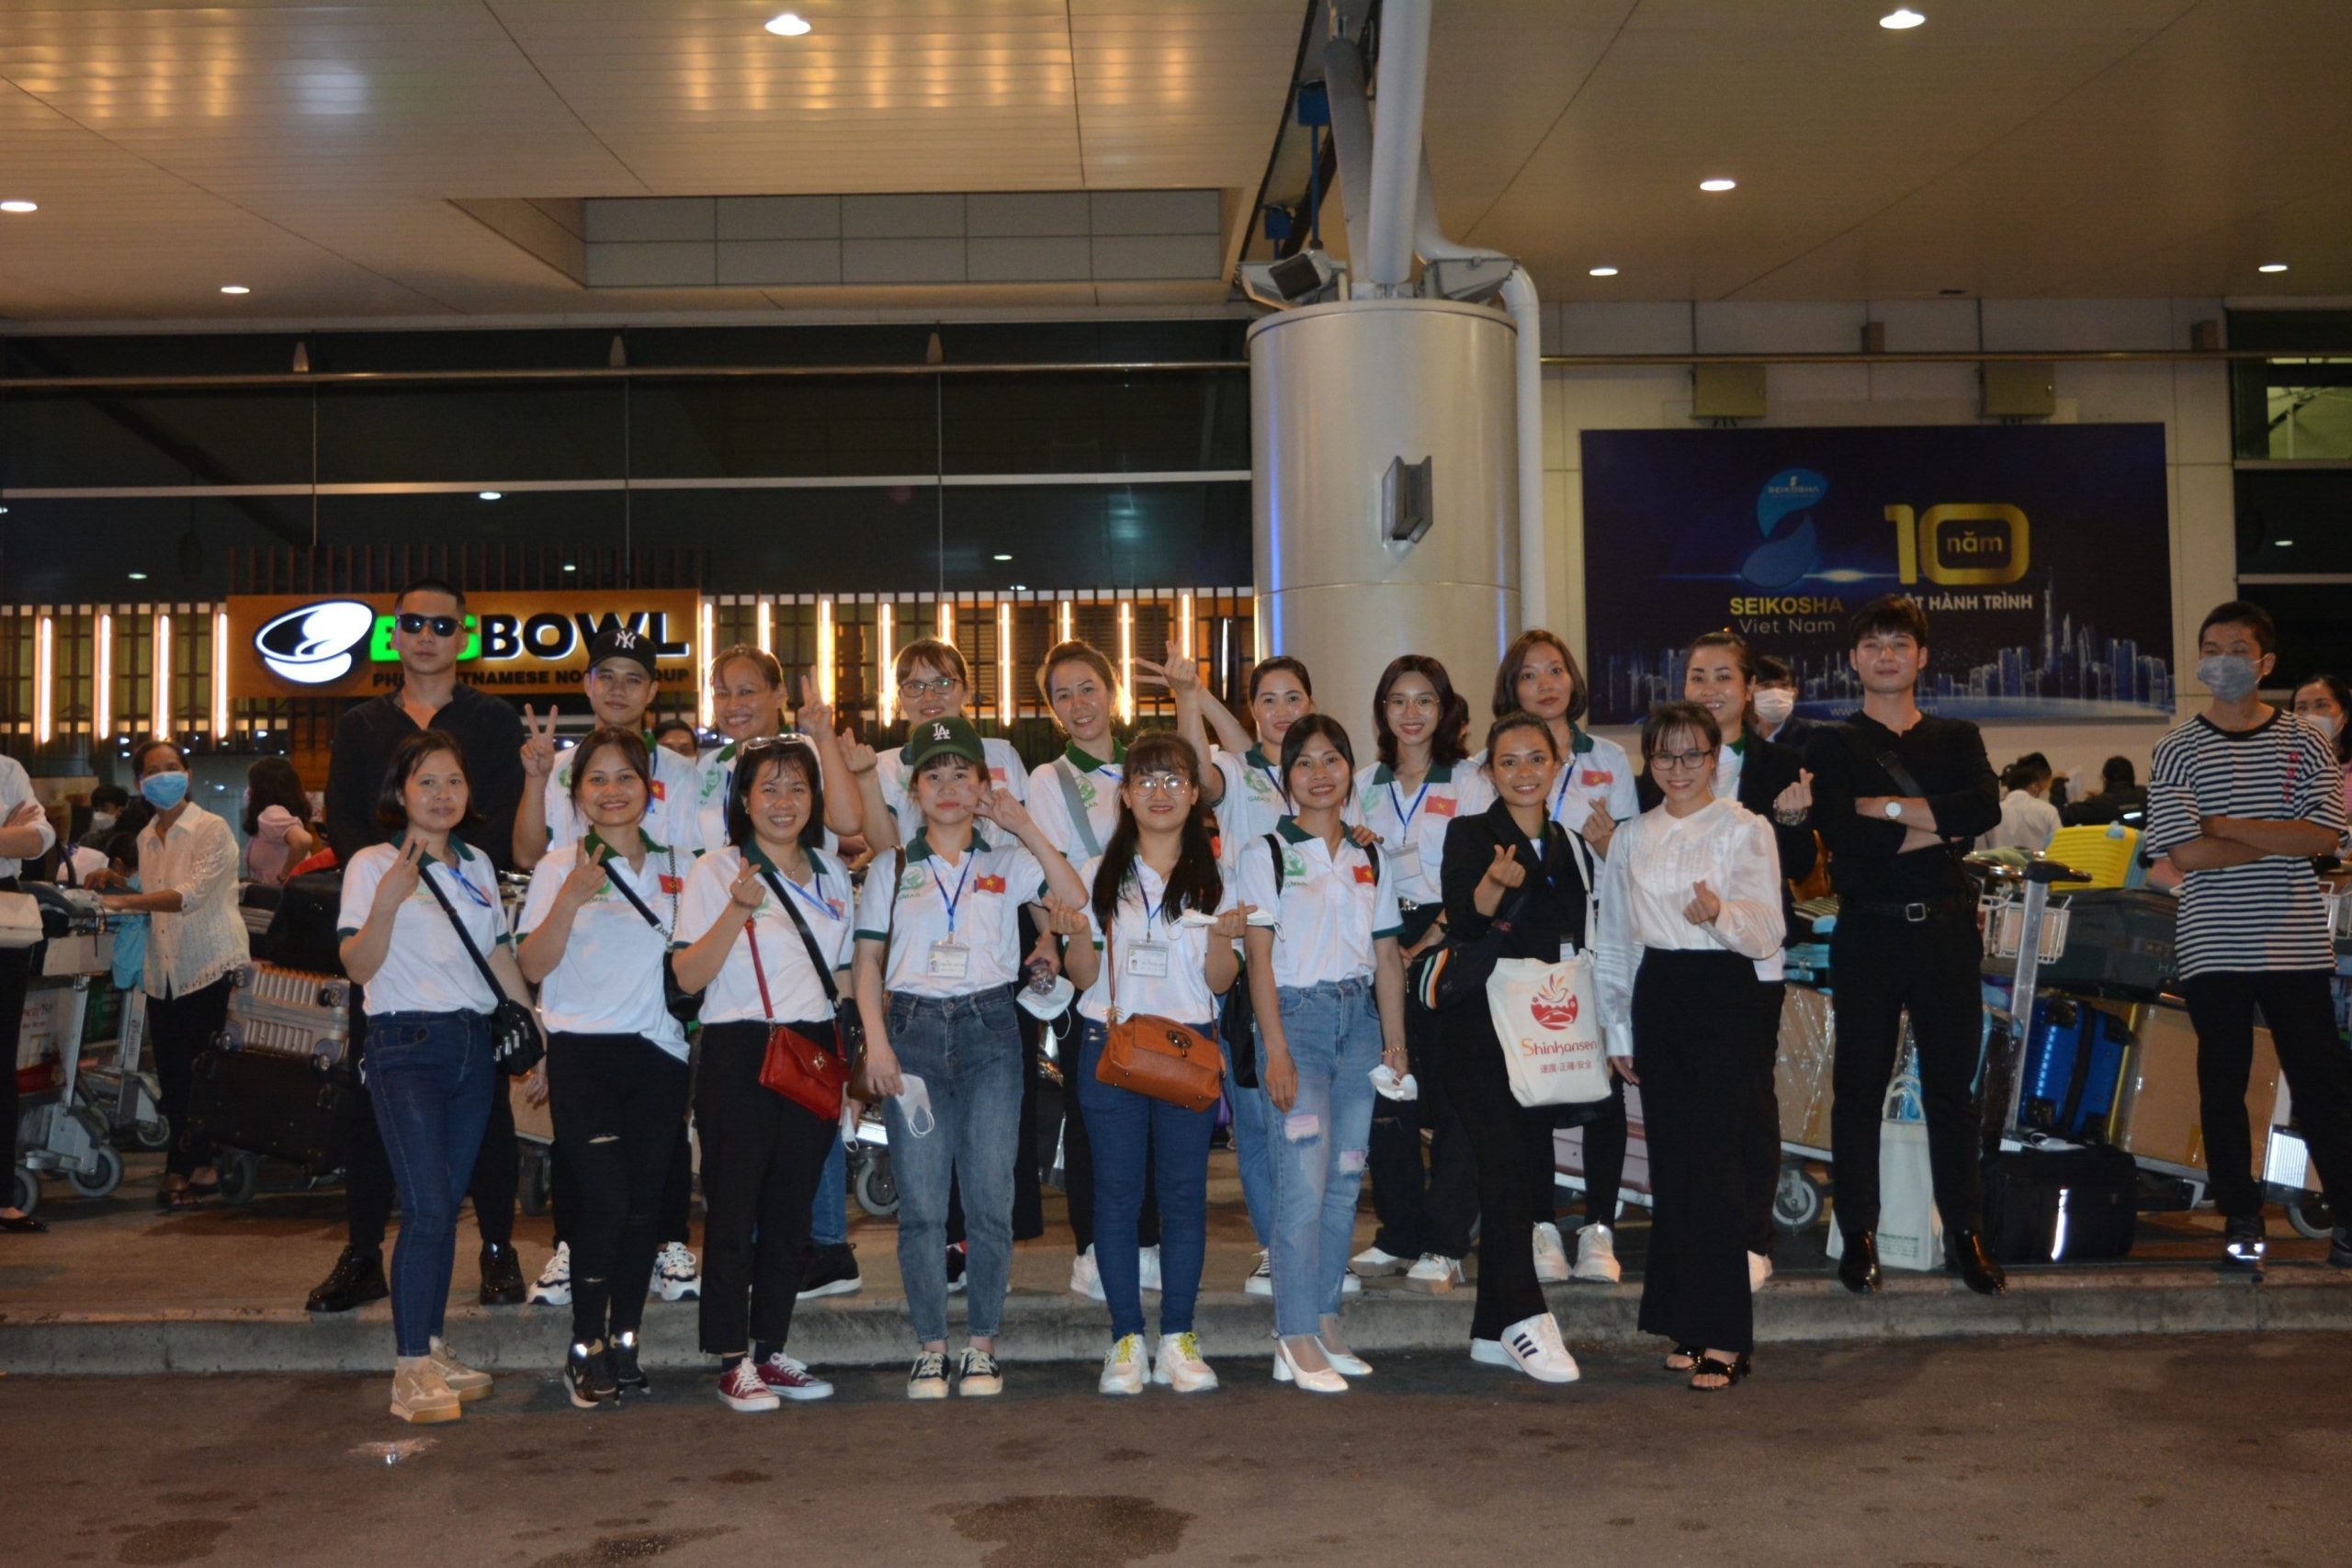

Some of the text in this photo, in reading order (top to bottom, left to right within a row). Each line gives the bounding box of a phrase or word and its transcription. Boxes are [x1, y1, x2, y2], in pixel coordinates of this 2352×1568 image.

[1884, 503, 2030, 585] 10
[1947, 531, 2003, 553] năm
[1729, 596, 1844, 615] SEIKOSHA
[1928, 592, 1978, 611] HÀNH
[1983, 592, 2033, 610] TRÌNH
[1738, 618, 1836, 634] Viet Nam
[370, 612, 689, 662] BBOWL
[615, 630, 636, 649] NY
[932, 722, 951, 741] LA
[1521, 1038, 1598, 1057] Shinkansen
